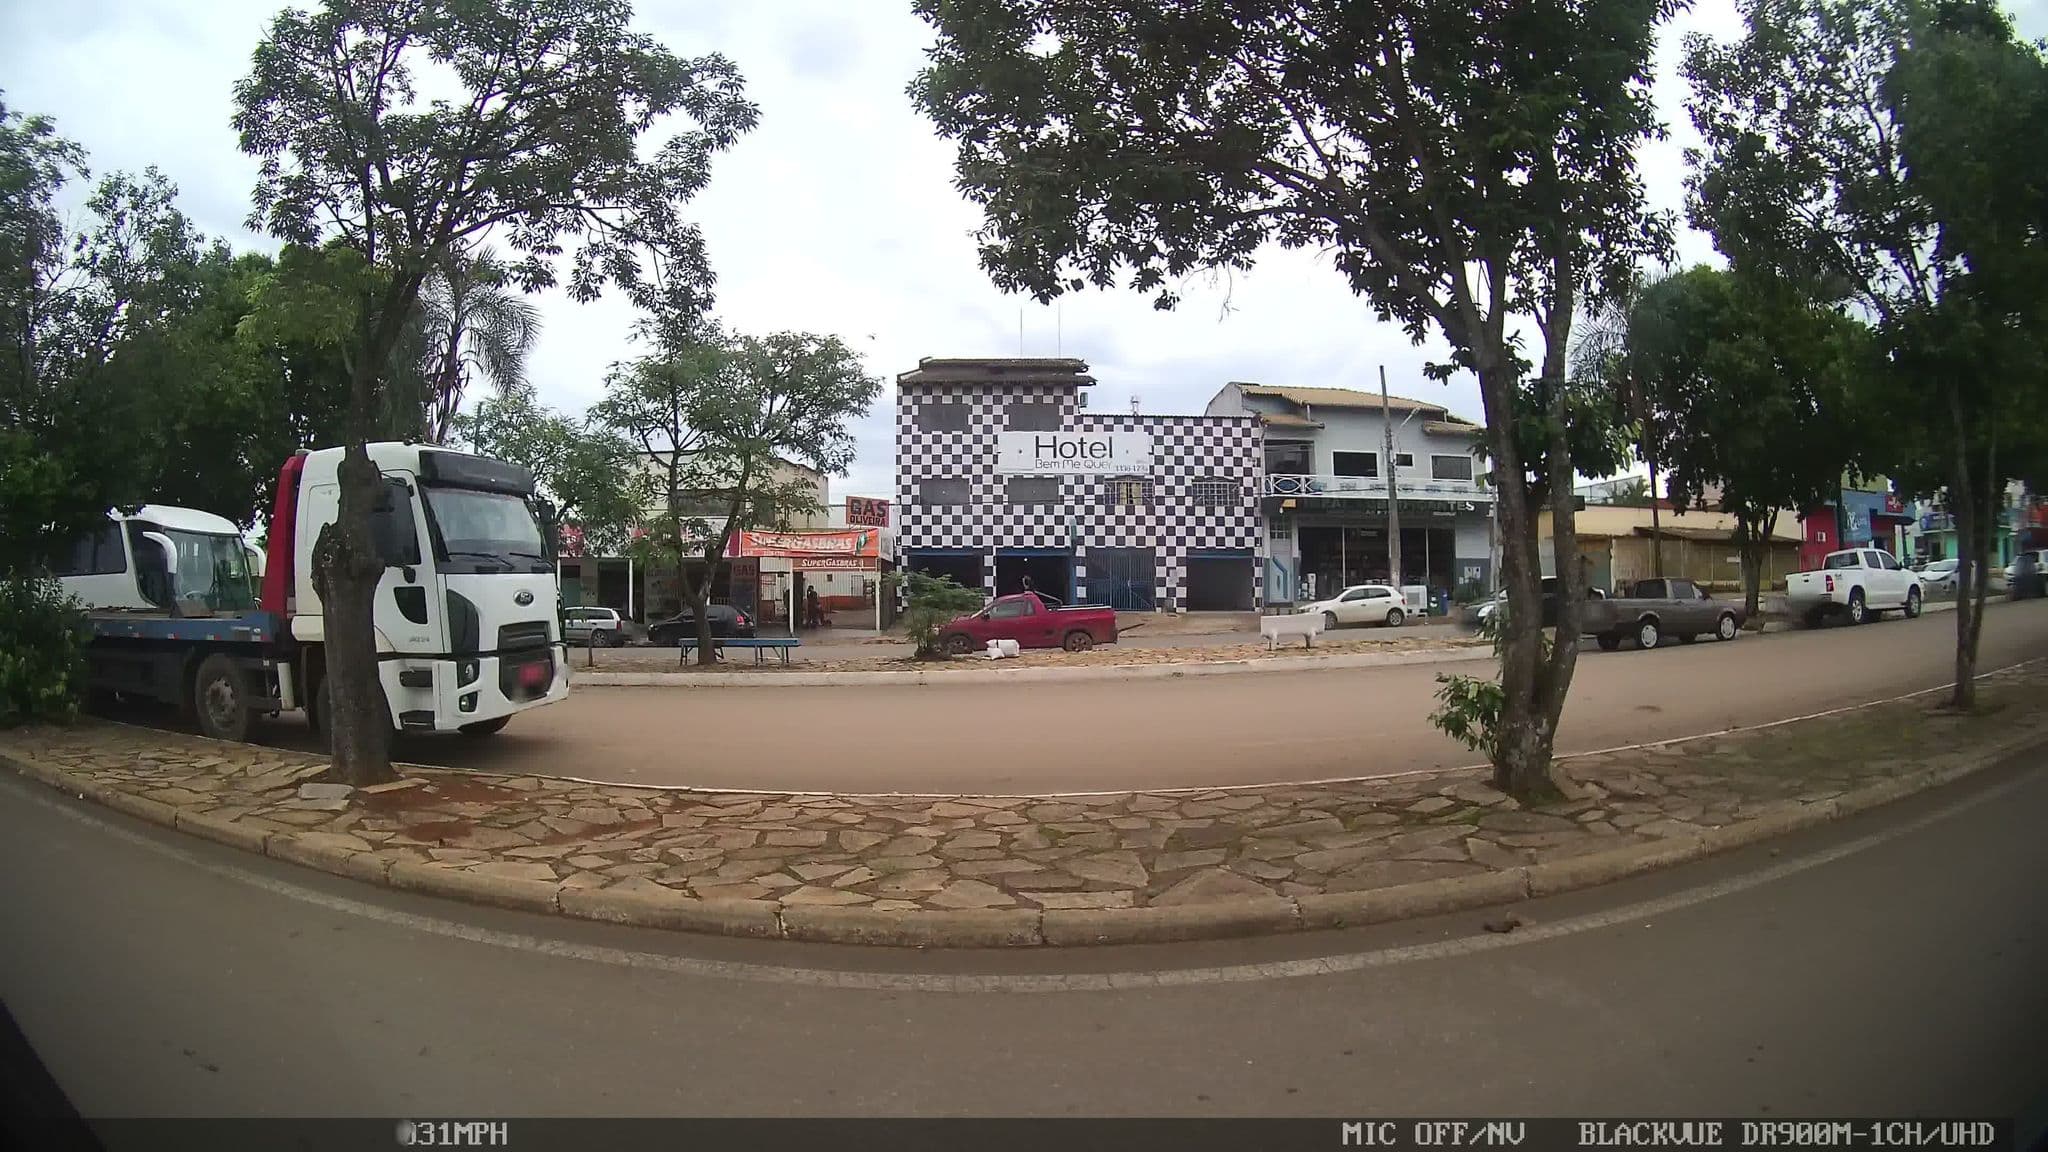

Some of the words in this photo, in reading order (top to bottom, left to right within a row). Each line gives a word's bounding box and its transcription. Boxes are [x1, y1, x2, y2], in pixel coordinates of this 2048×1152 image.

[1035, 435, 1113, 459] Hotel
[1035, 459, 1060, 469] Bem
[1063, 459, 1081, 469] Me
[851, 499, 886, 518] GAS
[850, 515, 886, 527] OLIVEIRA
